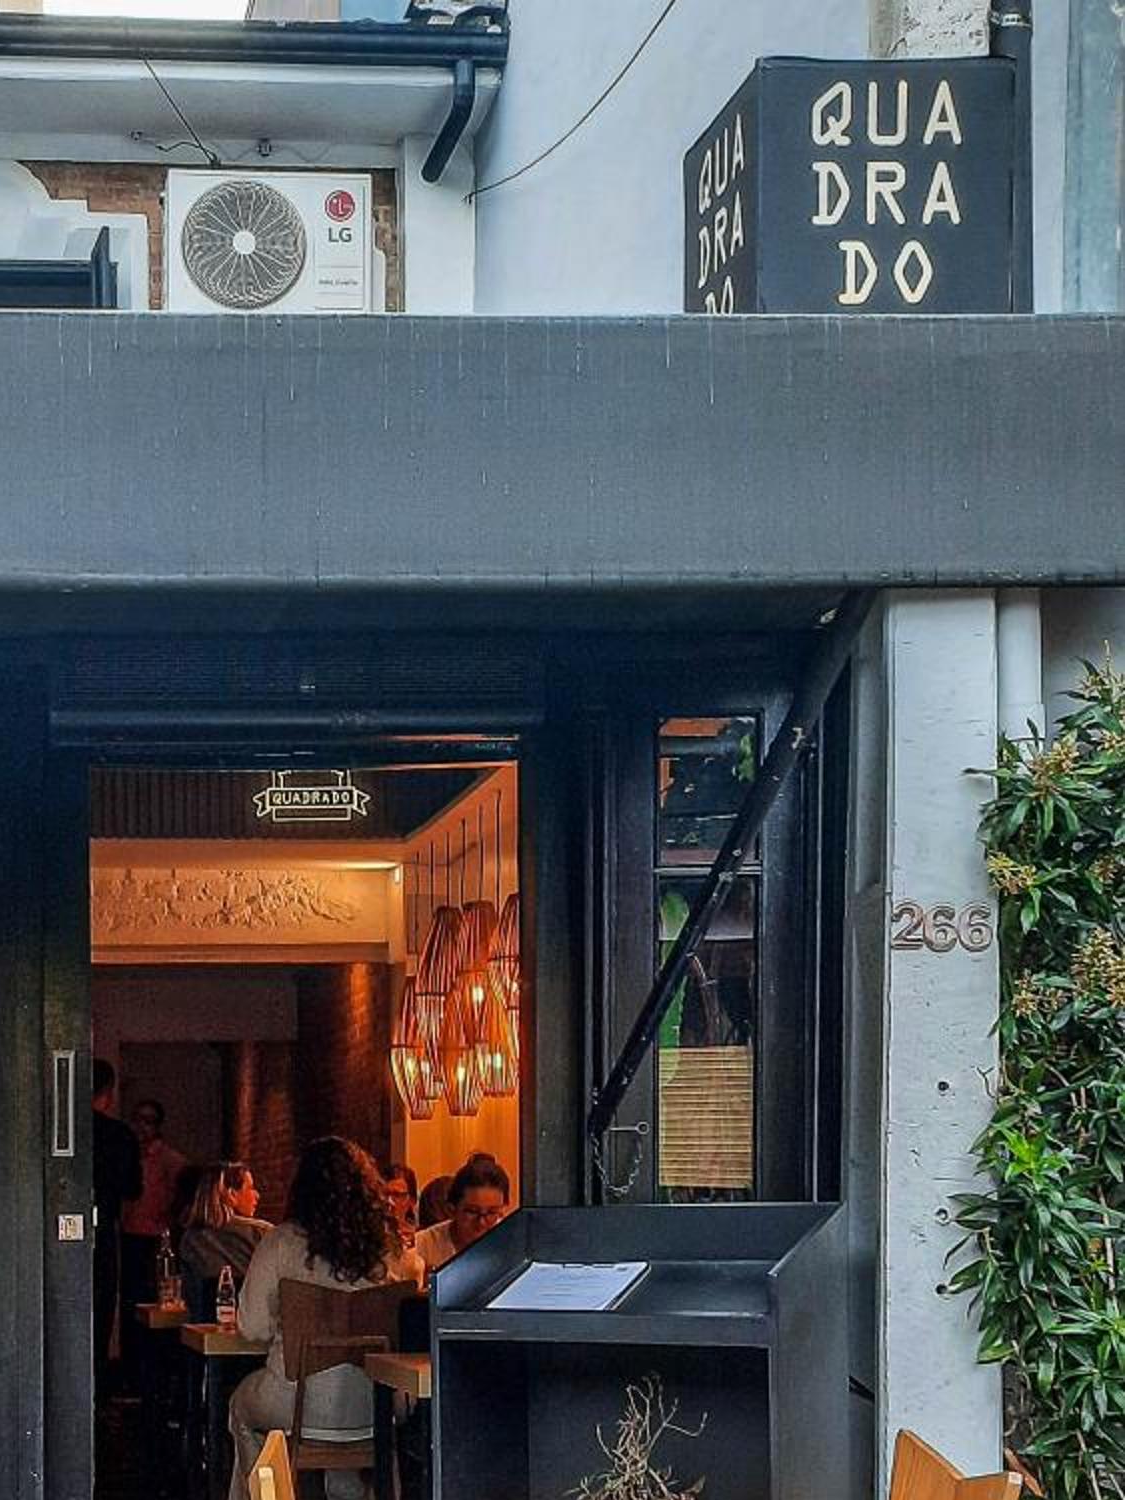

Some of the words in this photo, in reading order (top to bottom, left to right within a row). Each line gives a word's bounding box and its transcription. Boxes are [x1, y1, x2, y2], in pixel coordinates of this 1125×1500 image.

[811, 79, 962, 146] QUA
[698, 113, 744, 215] QUA
[811, 161, 961, 225] DRA
[328, 227, 352, 243] LG
[698, 191, 744, 289] DRA
[837, 240, 933, 305] DO
[272, 791, 350, 805] QUADRADO
[891, 901, 993, 952] 266
